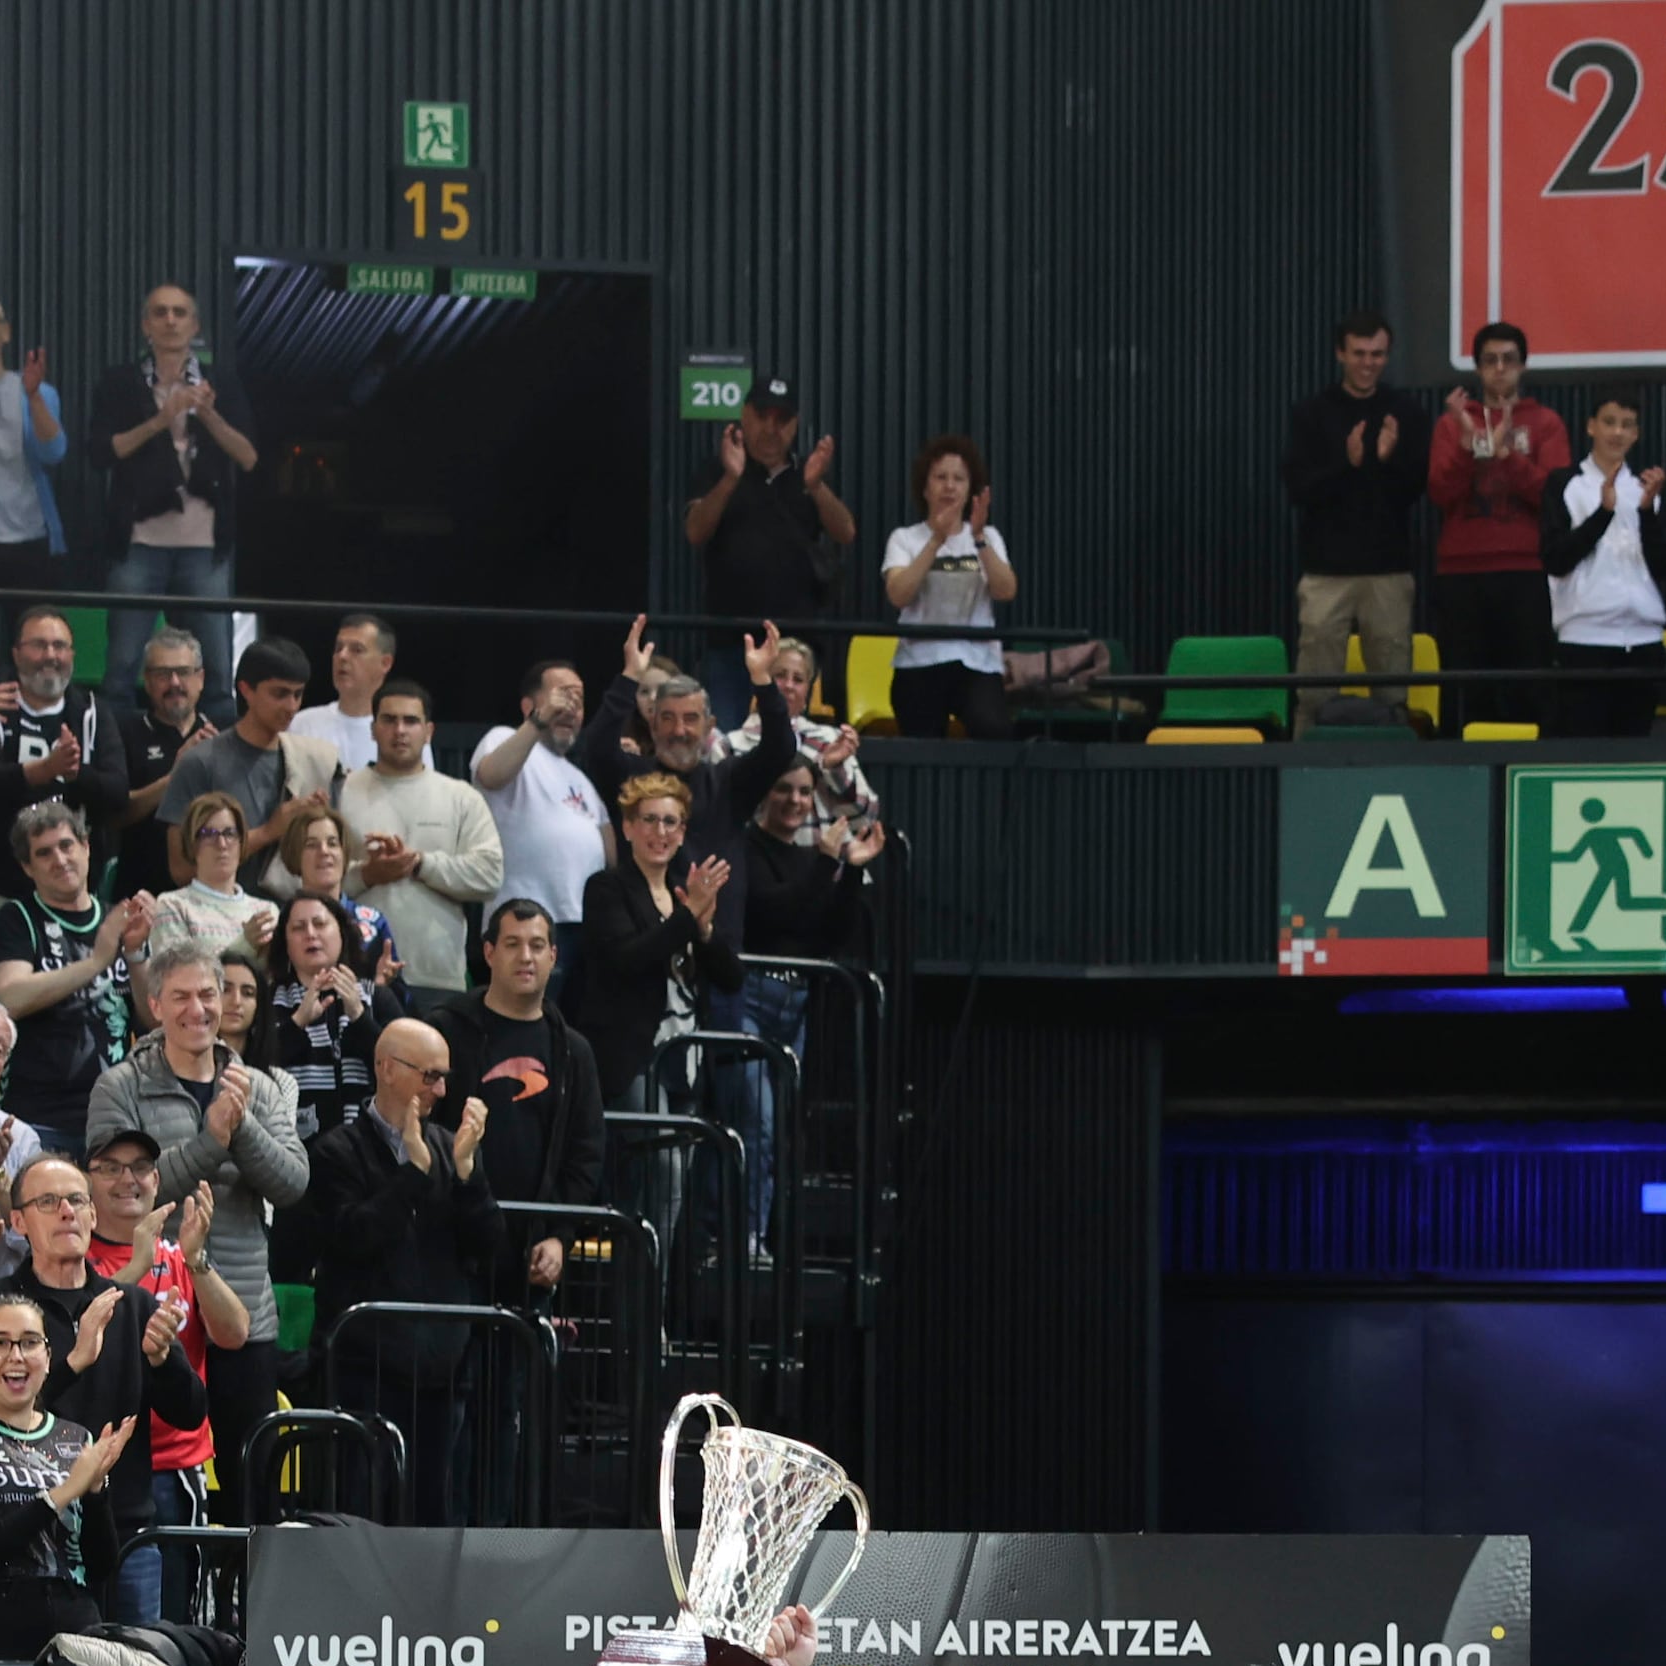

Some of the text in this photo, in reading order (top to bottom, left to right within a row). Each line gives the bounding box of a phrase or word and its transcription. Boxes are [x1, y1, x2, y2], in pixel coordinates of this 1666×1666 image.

[404, 181, 470, 240] 15
[356, 268, 425, 292] SALIDA
[690, 380, 742, 407] 210
[1324, 794, 1447, 919] A
[817, 1618, 922, 1657] ETAN
[935, 1618, 1211, 1658] AIRERATZEA
